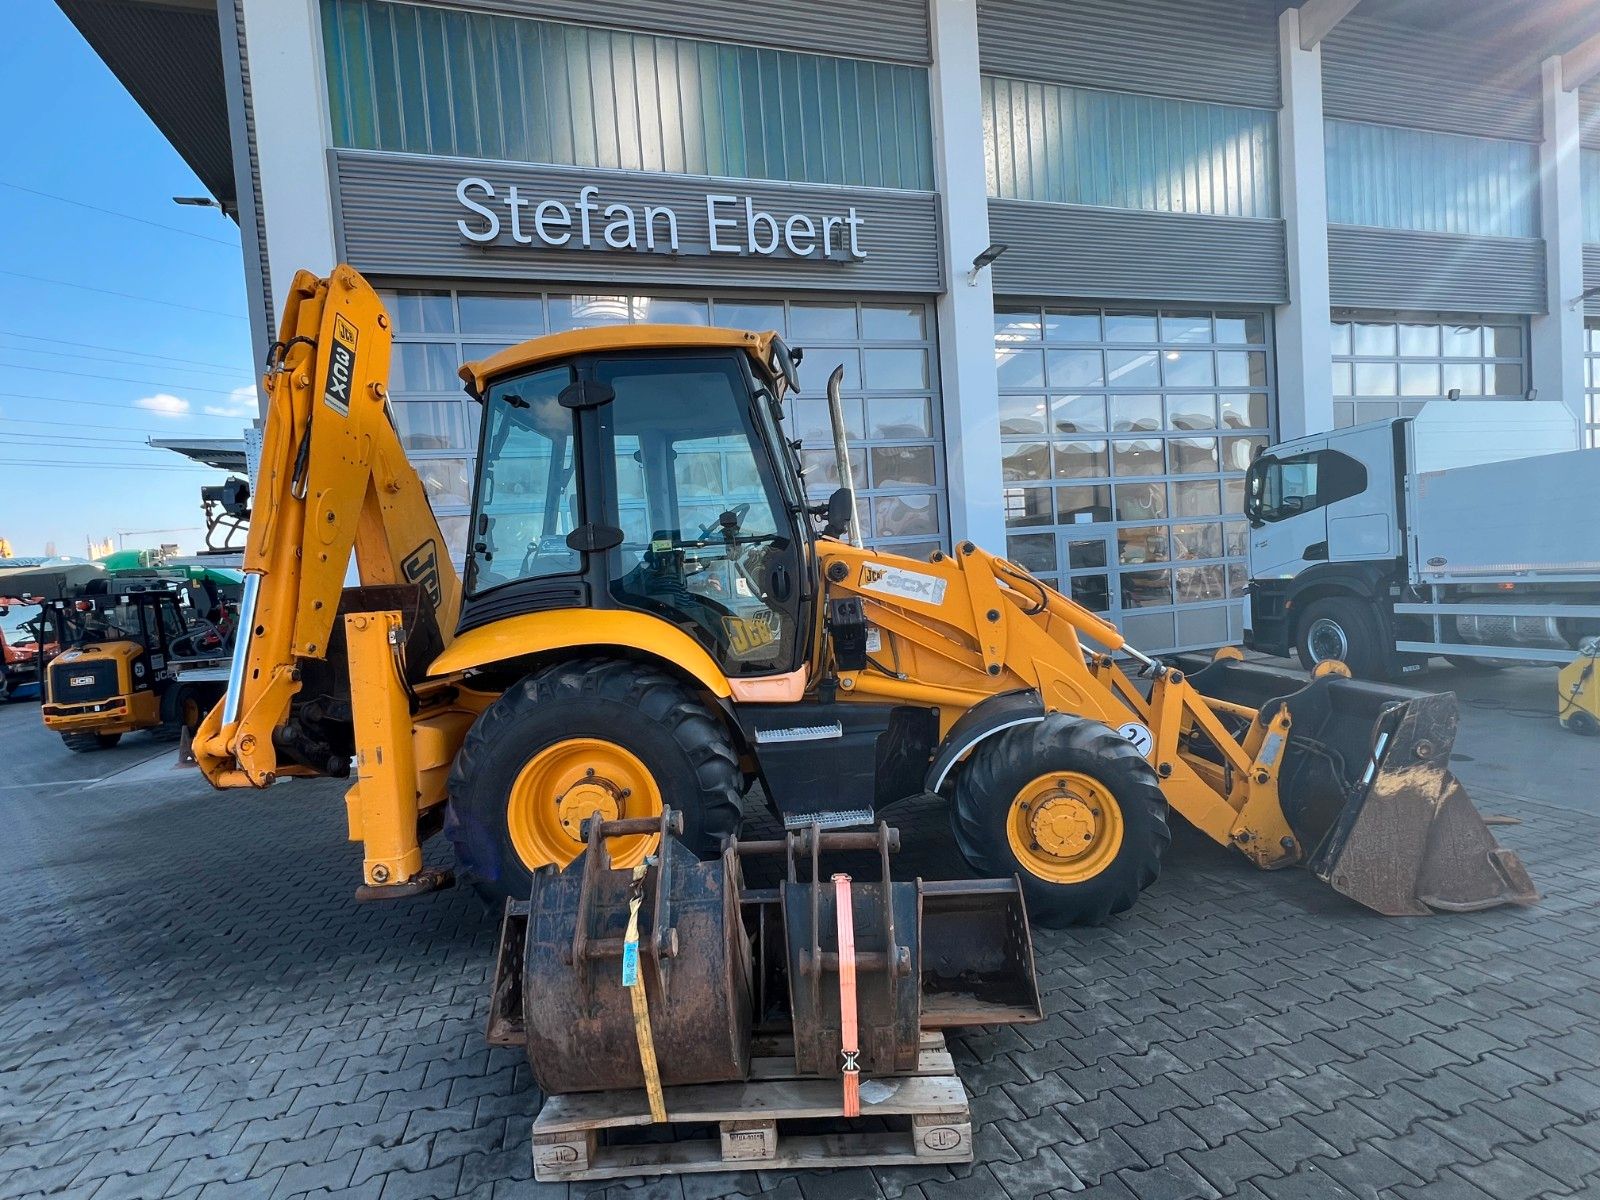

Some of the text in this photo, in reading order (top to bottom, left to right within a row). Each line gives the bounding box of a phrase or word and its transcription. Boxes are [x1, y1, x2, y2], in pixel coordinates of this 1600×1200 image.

[456, 177, 867, 258] Stefan Ebert
[330, 347, 349, 400] 3CX
[886, 574, 932, 596] 3CX
